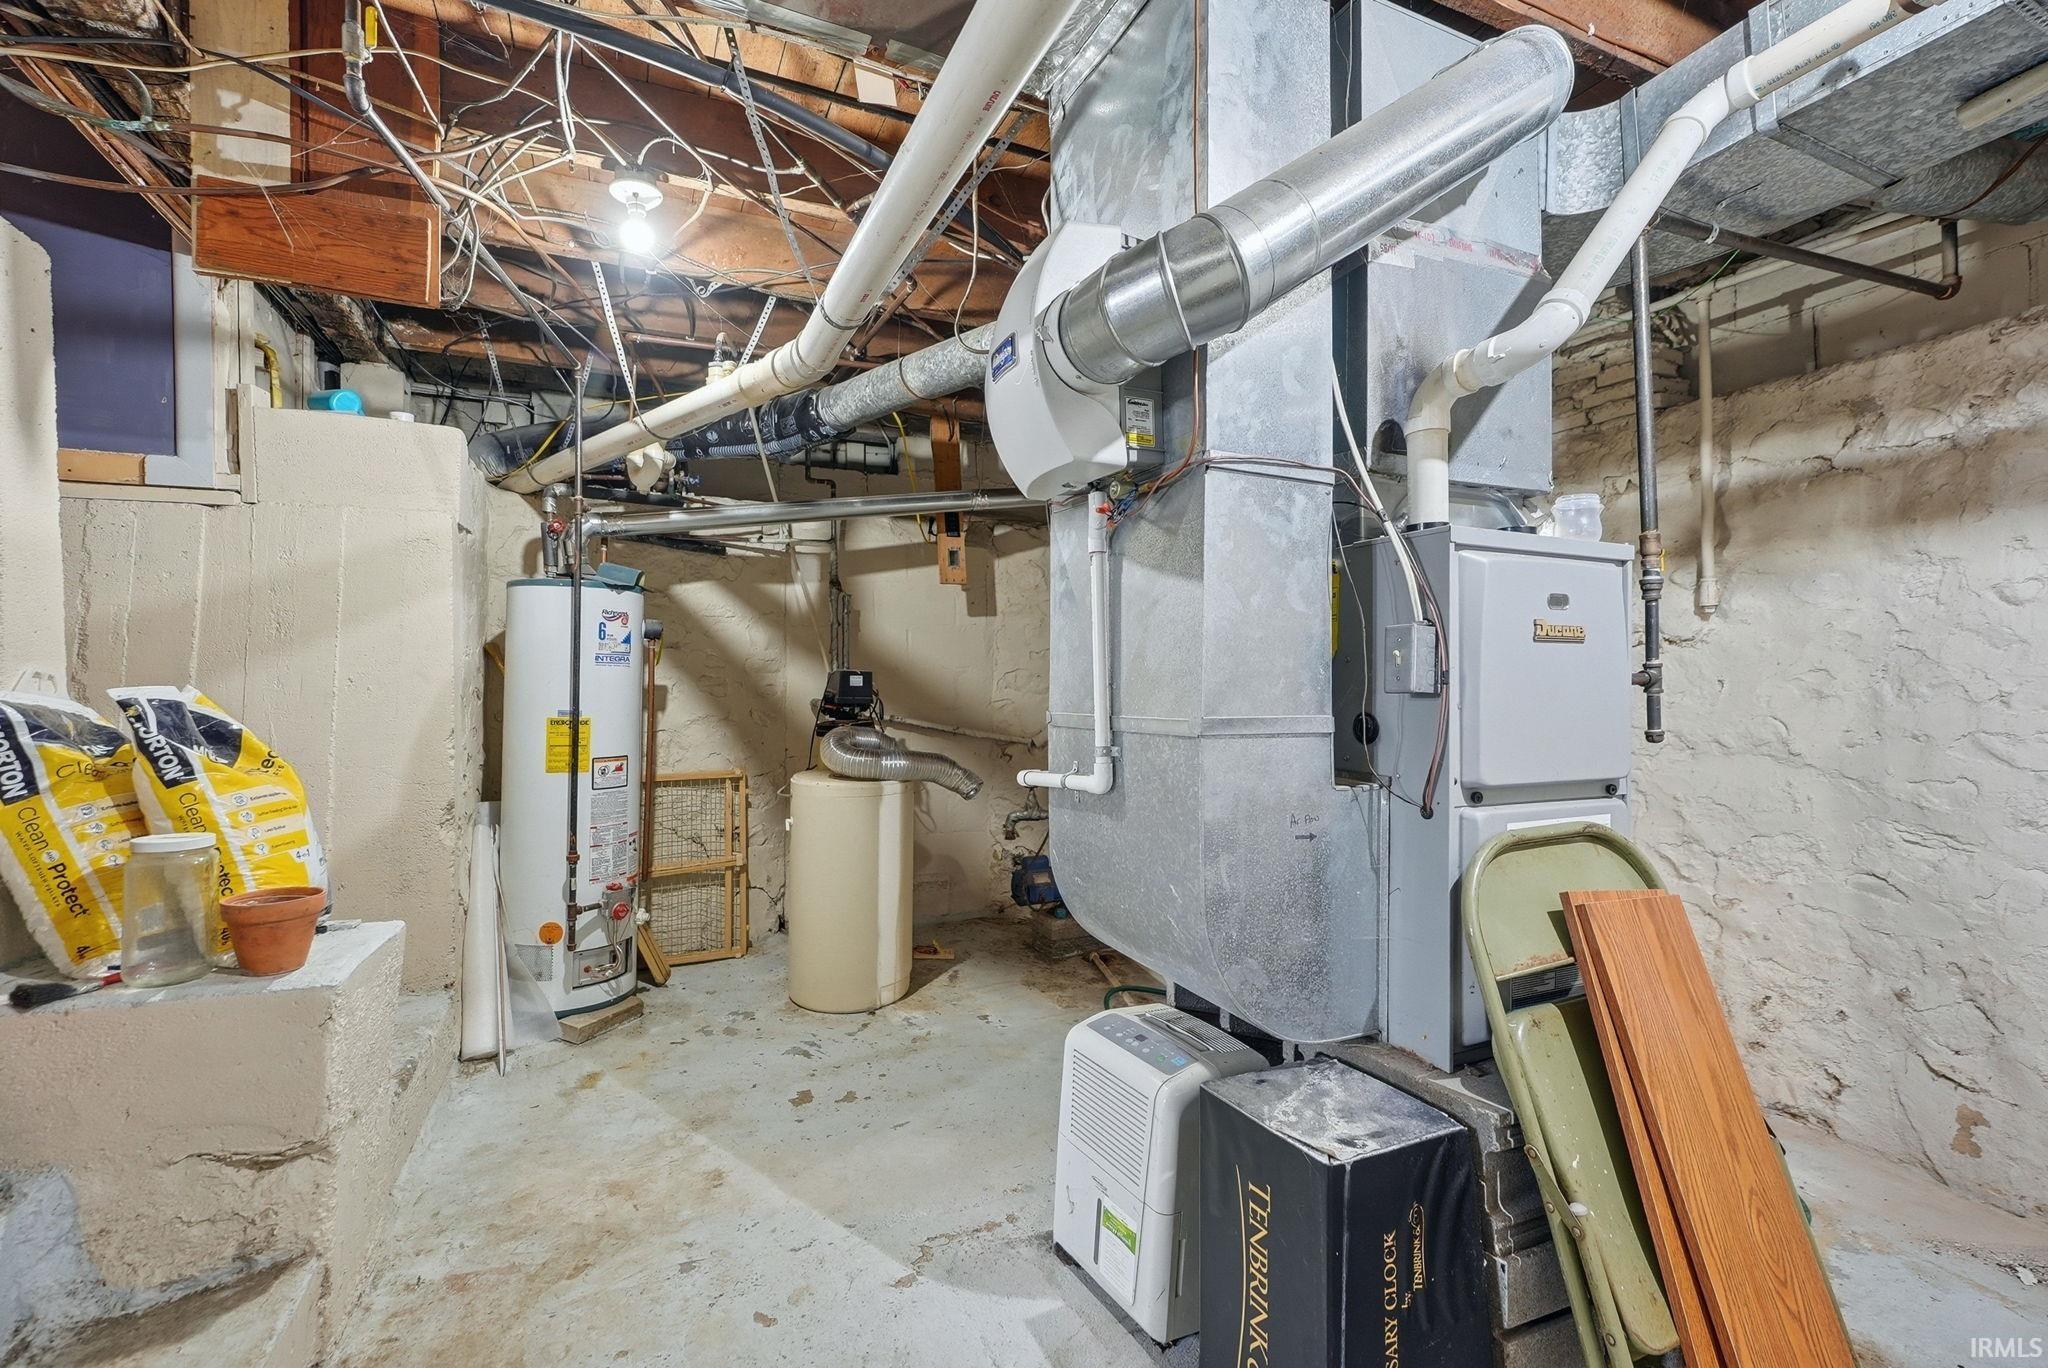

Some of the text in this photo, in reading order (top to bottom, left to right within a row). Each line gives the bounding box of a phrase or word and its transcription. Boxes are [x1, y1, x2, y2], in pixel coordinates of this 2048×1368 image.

[594, 655, 631, 663] INTEGRA
[598, 621, 607, 641] 6
[1534, 618, 1586, 639] Ducane
[0, 722, 28, 799] ORTON
[18, 806, 49, 852] Clean
[48, 862, 90, 918] Protect
[1247, 1180, 1271, 1366] TENBRINK
[1383, 1228, 1397, 1311] CLOCK
[1412, 1236, 1424, 1291] TENBRINK
